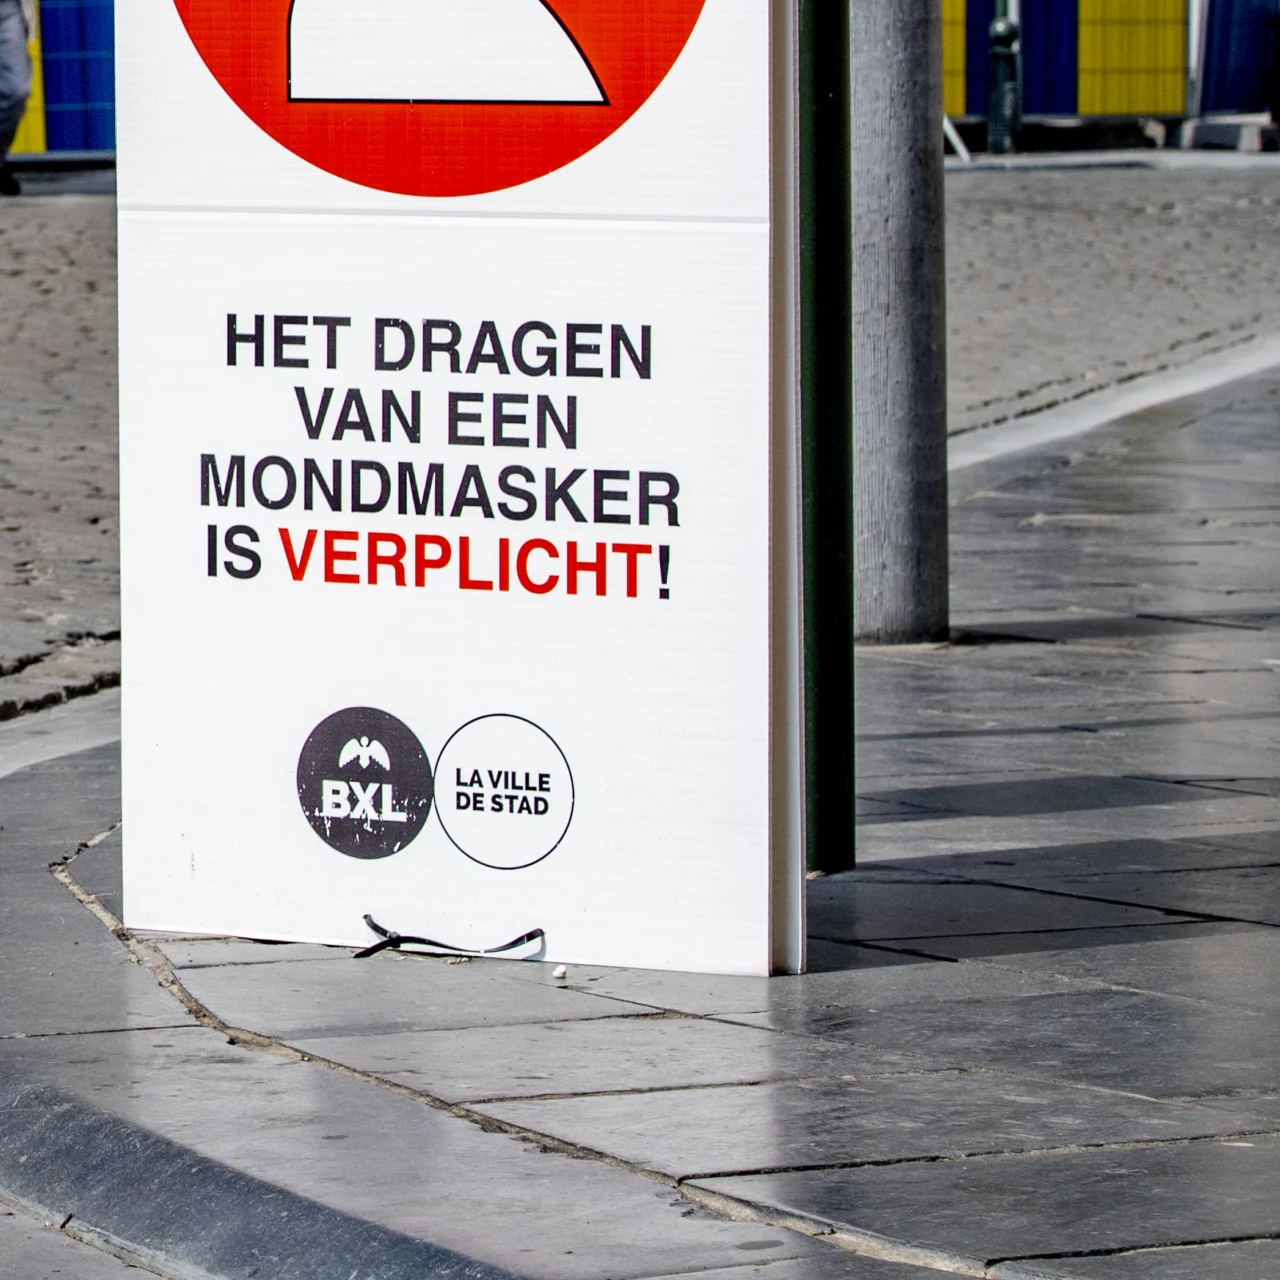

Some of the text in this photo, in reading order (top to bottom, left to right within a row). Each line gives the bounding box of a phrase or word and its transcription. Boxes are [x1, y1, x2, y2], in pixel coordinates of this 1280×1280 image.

[226, 313, 652, 380] HET DRAGEN
[293, 386, 577, 450] VAN EEN
[200, 453, 681, 527] MONDMASKER
[207, 523, 670, 600] IS VERPLICHT!
[321, 779, 407, 823] BXL
[456, 768, 551, 793] LA VILLE
[456, 791, 549, 816] DE STAD
